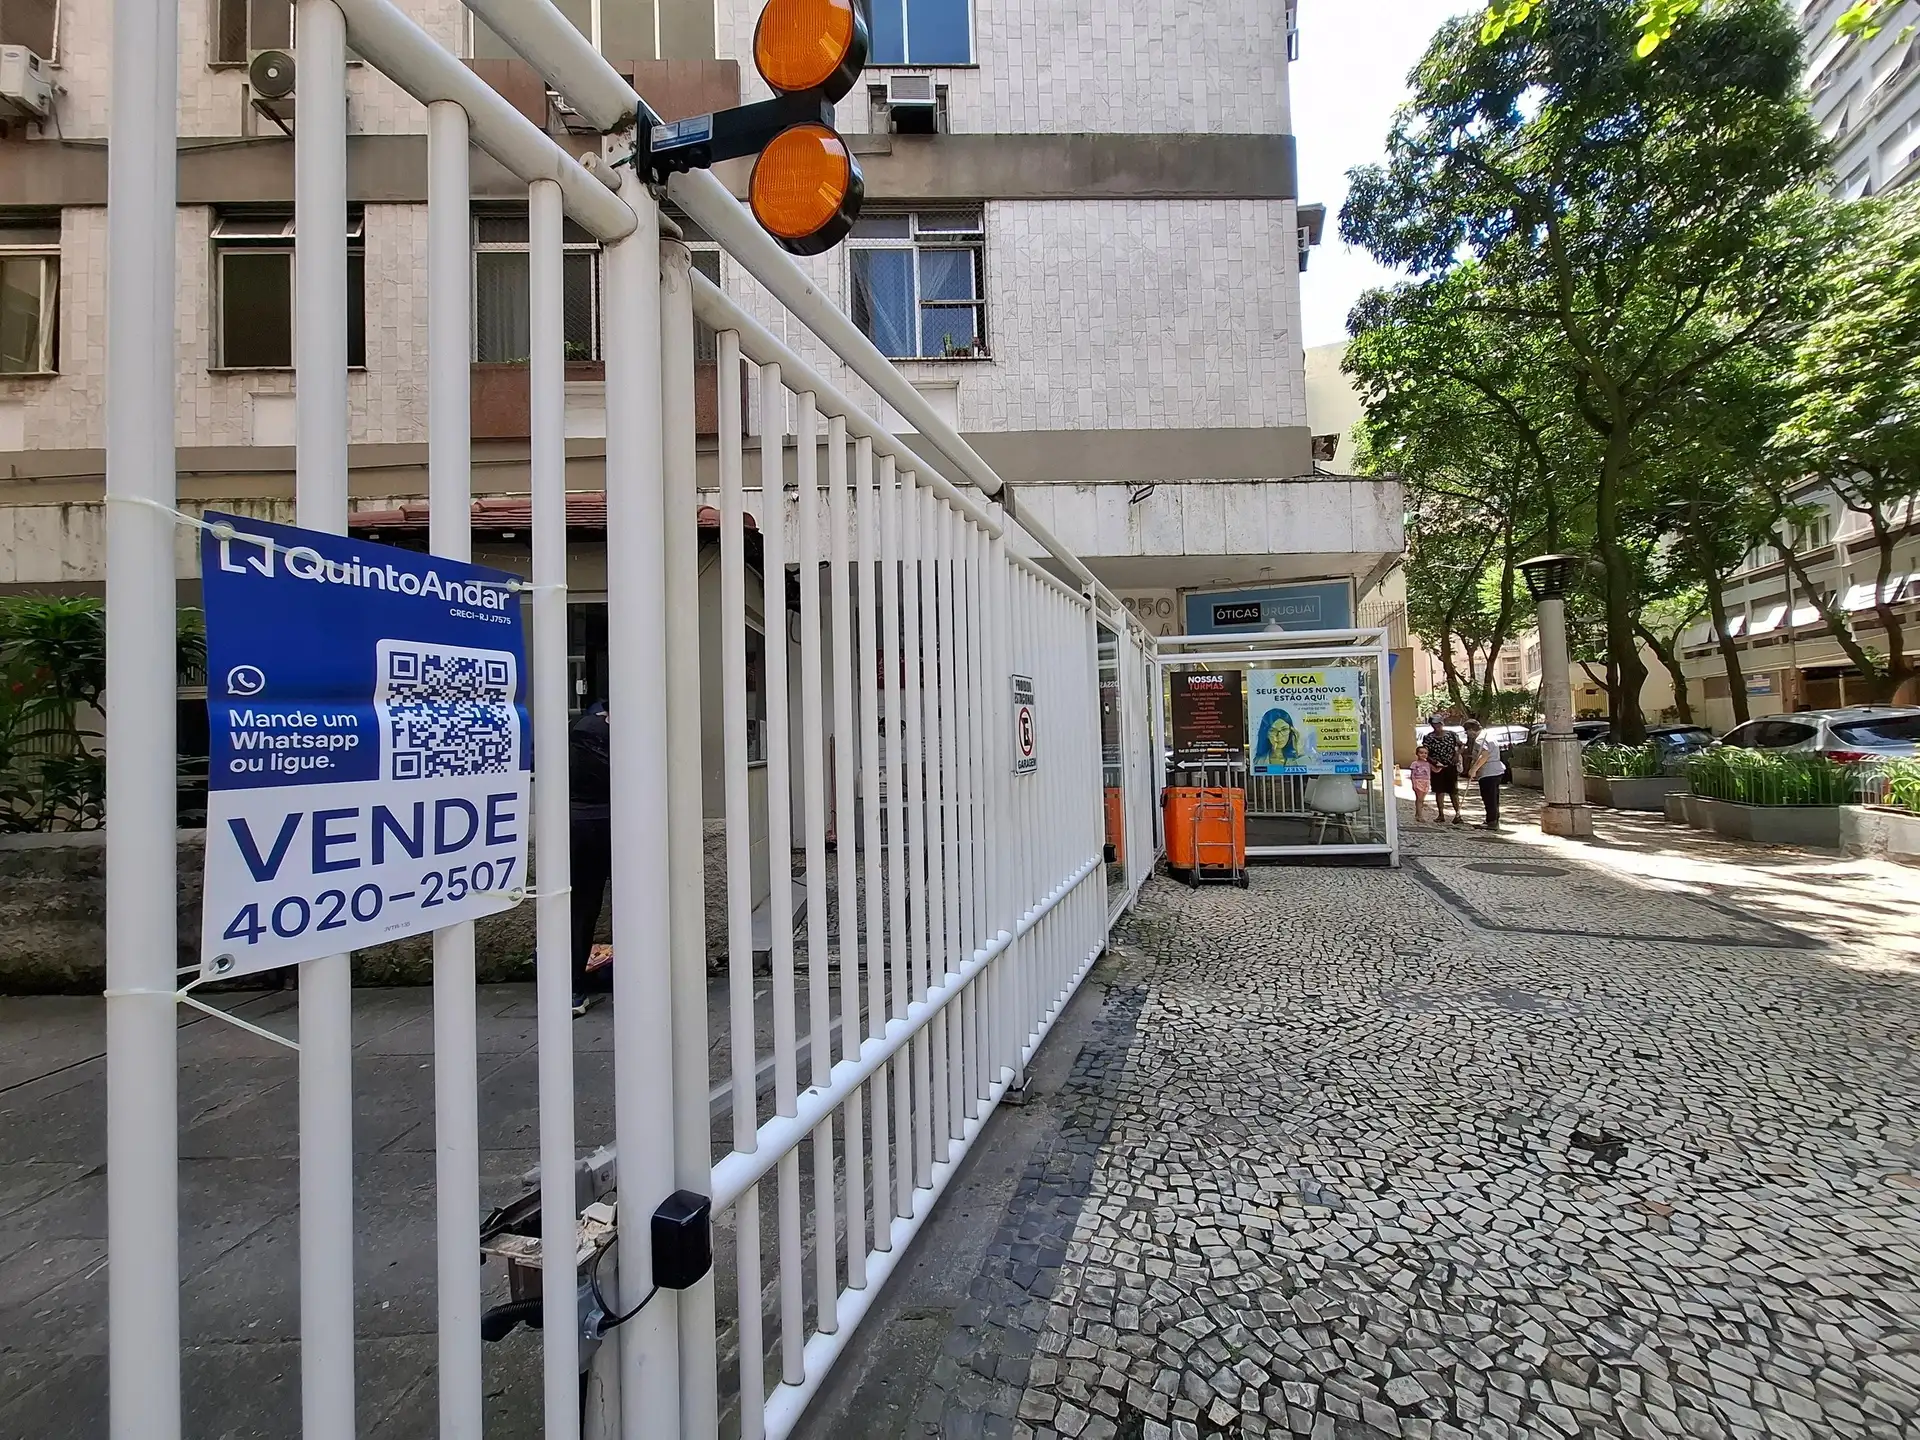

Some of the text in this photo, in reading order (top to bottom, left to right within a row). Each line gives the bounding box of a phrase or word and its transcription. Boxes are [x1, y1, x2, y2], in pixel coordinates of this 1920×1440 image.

[284, 546, 509, 611] QuintoAndar
[449, 608, 512, 625] CRECI-RJ J7575
[1216, 604, 1316, 620] ÓTICAS URUGUAI
[1187, 675, 1223, 684] NOSSAS
[1189, 682, 1224, 690] TURMAS
[1280, 673, 1317, 685] ÓTICA
[1274, 694, 1302, 702] ESTÃO
[1279, 686, 1313, 694] ÓCULOS
[228, 707, 358, 729] Mande um
[230, 731, 359, 752] Whatsapp
[228, 751, 336, 775] ou ligue.
[227, 792, 519, 884] VENDE
[222, 856, 517, 946] 4020-2507
